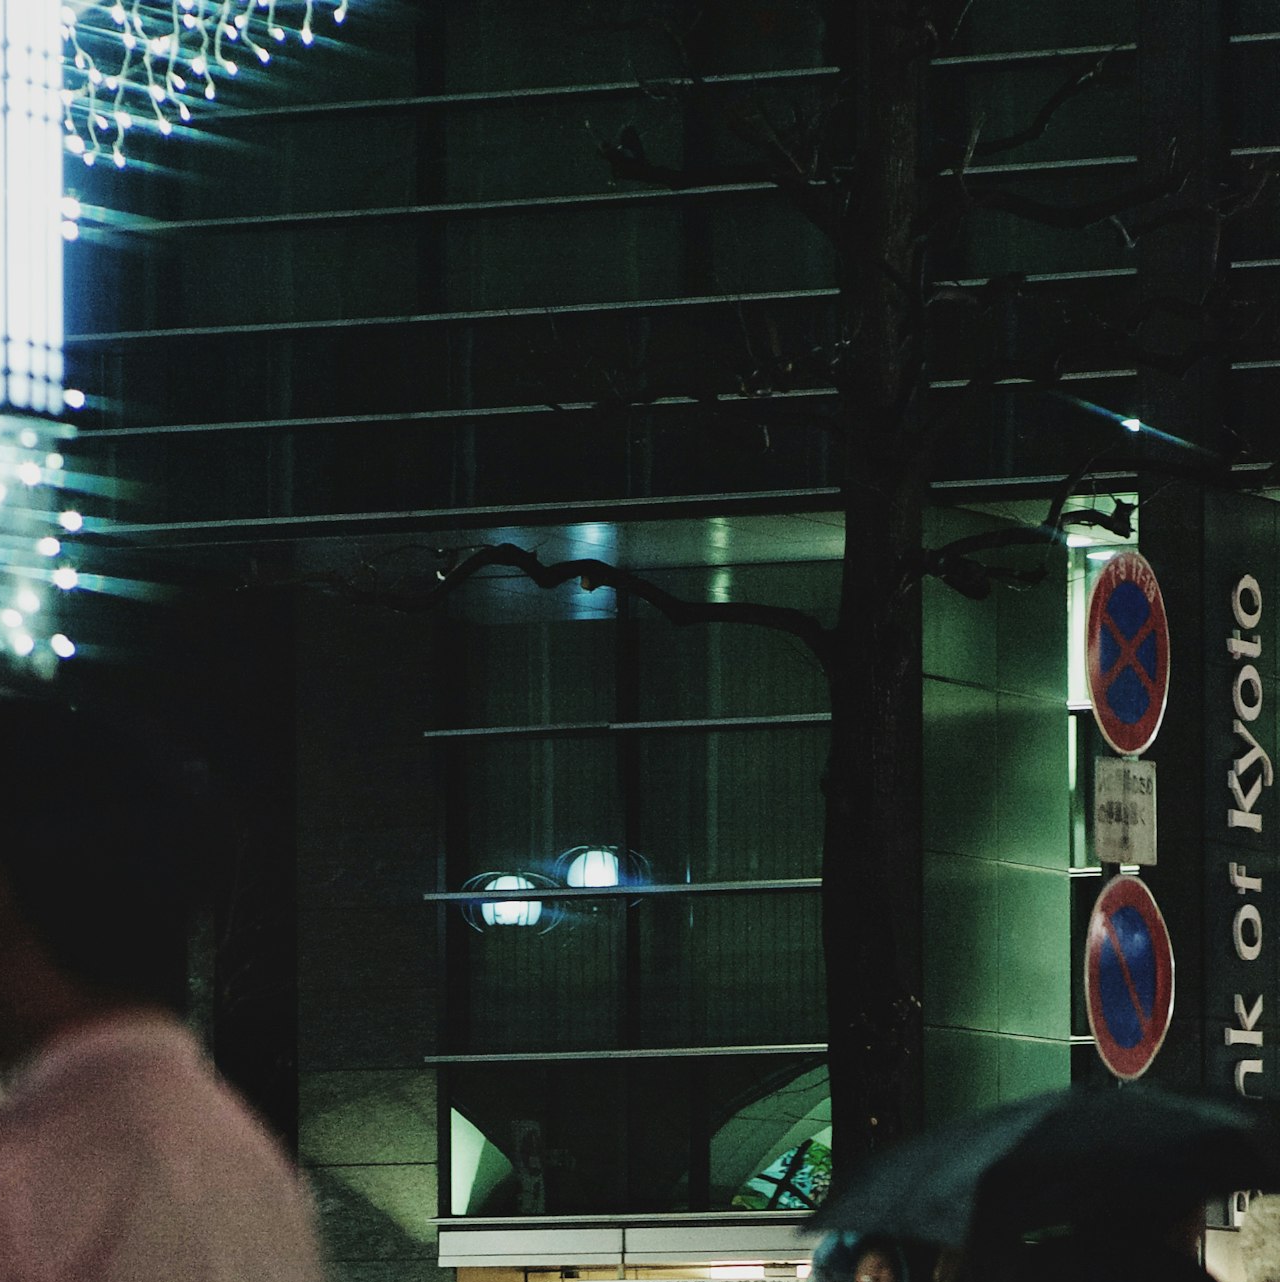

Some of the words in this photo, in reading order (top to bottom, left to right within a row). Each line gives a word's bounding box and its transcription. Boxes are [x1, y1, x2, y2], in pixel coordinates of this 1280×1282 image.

[1226, 573, 1274, 833] Kyoto
[1228, 861, 1265, 961] of
[1224, 993, 1265, 1228] Bnk
